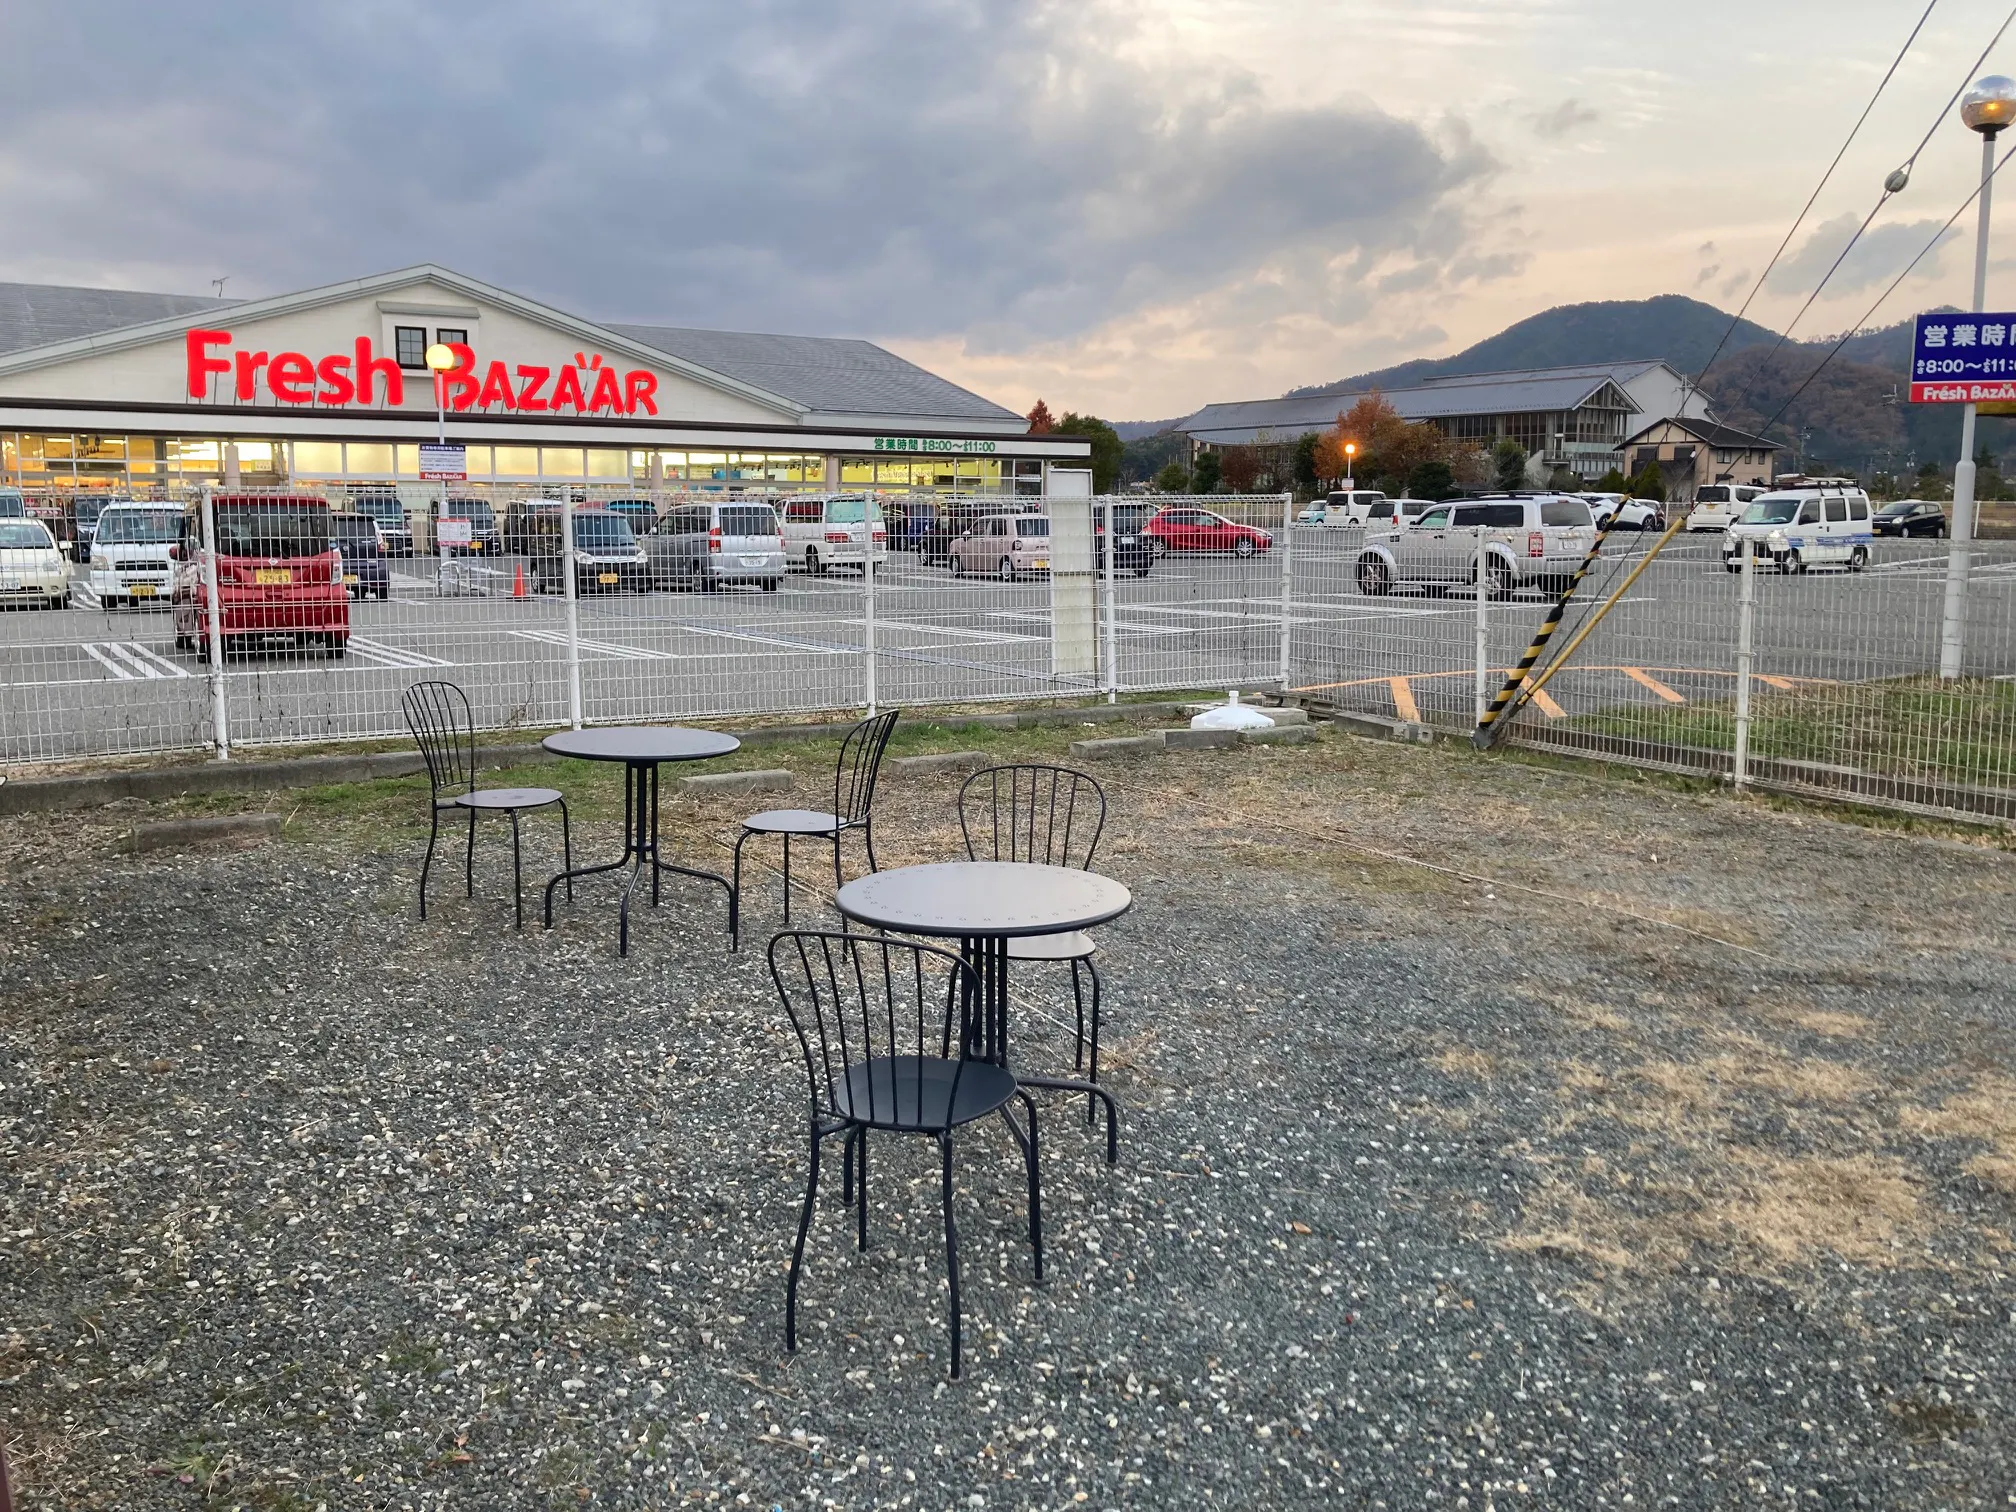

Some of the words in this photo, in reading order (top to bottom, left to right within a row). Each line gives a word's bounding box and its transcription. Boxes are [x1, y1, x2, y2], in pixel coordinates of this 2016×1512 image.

[1924, 323, 2016, 348] 営業時
[186, 328, 404, 405] Fresh
[874, 437, 918, 450] 営業時間
